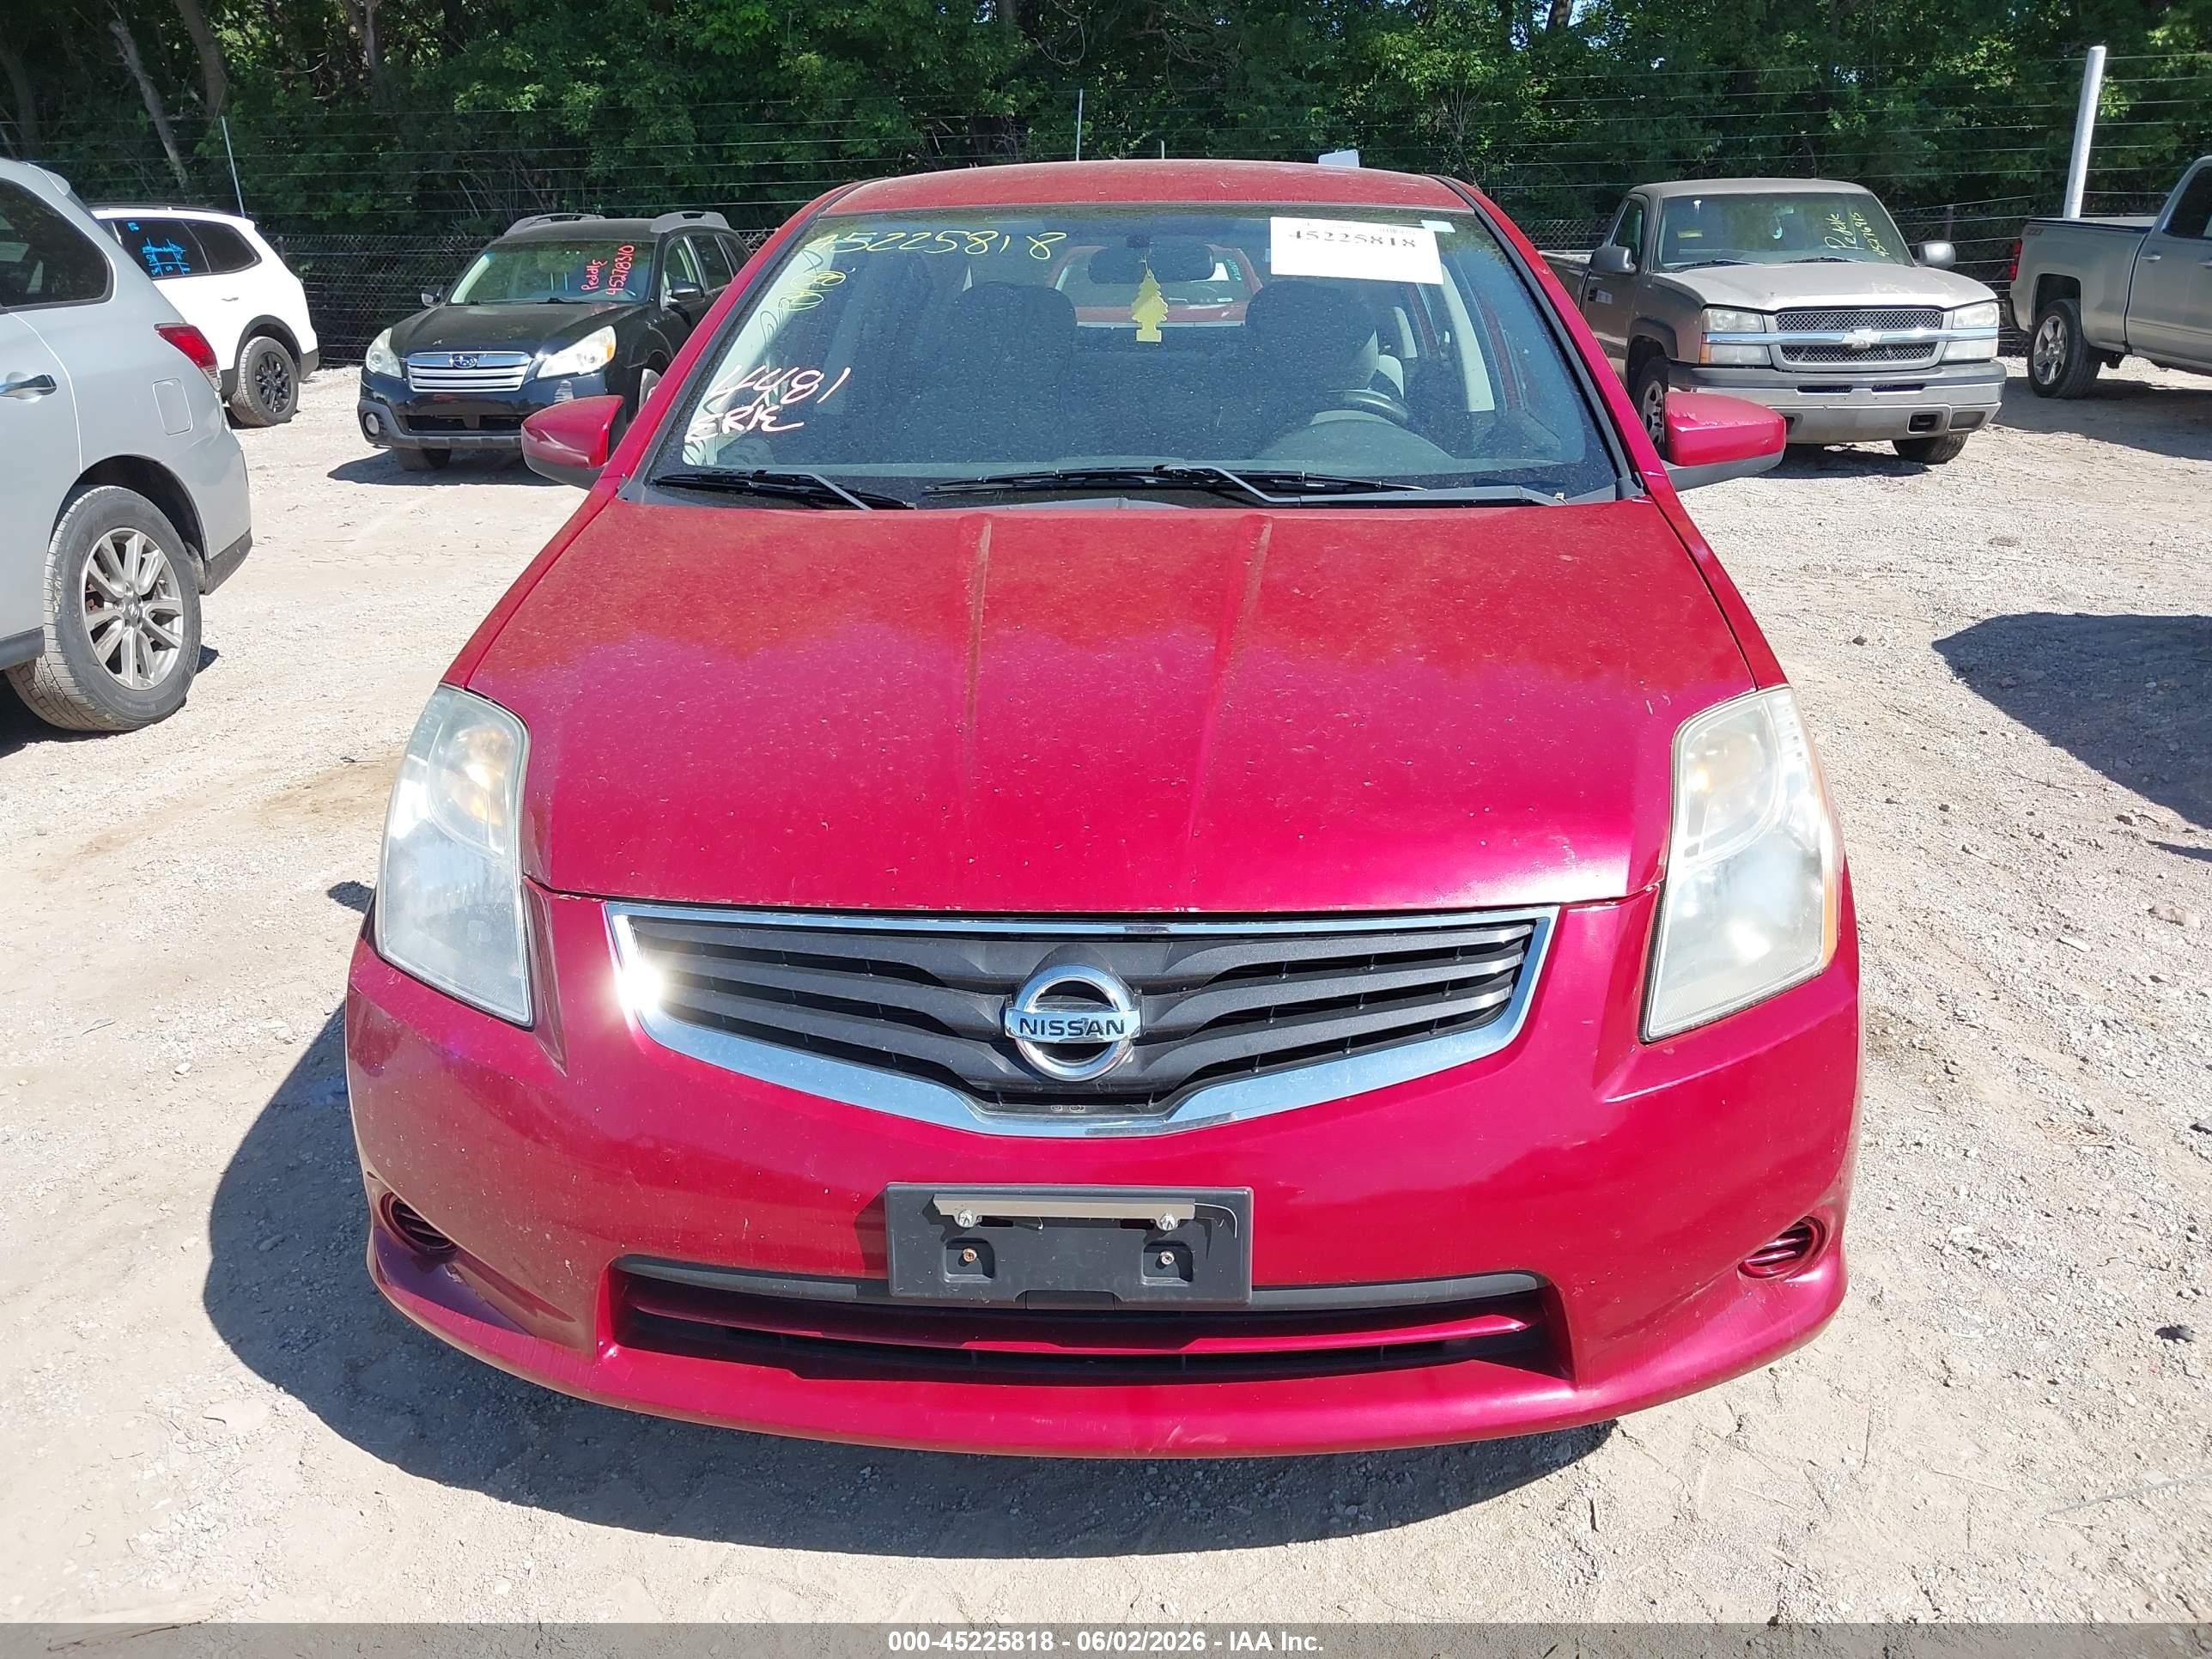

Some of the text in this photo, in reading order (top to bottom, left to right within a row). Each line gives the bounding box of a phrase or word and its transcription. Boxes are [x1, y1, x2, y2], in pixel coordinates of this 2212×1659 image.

[580, 259, 608, 290] Peddle
[605, 245, 635, 295] 45278310
[1019, 1018, 1125, 1036] NISSAN
